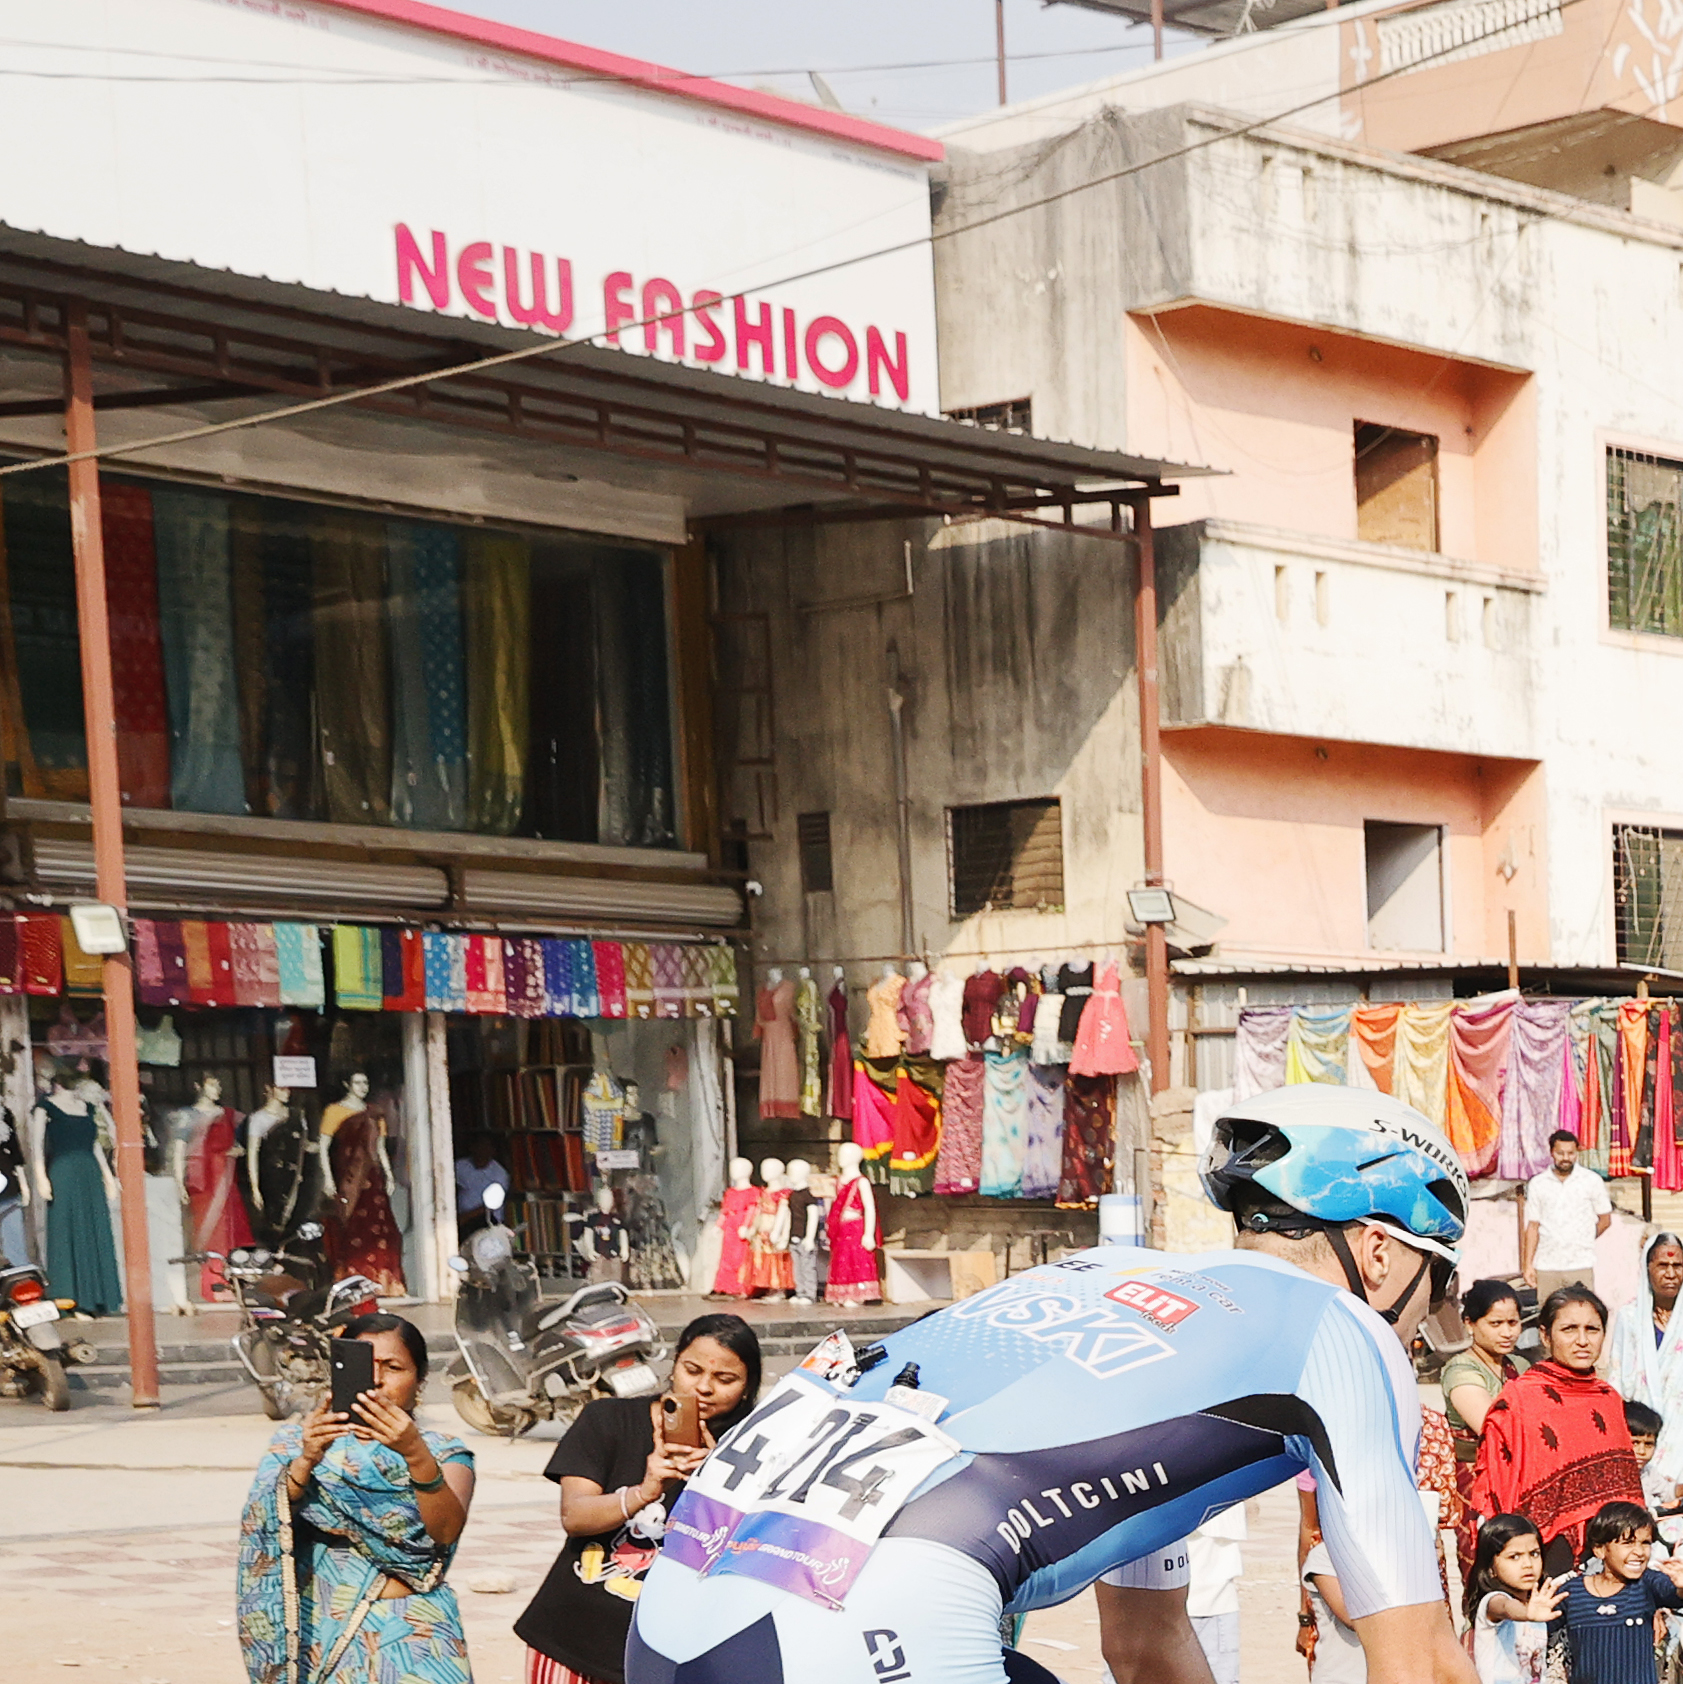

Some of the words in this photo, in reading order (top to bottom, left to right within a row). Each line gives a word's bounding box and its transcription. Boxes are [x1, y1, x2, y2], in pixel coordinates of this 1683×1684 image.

[394, 222, 571, 335] NEW
[603, 270, 909, 401] FASHION
[1369, 1119, 1467, 1199] S-WORKS
[951, 1284, 1178, 1379] VSKI
[1208, 1291, 1243, 1313] car
[757, 1408, 927, 1522] 214
[997, 1462, 1169, 1554] DOLTCINI
